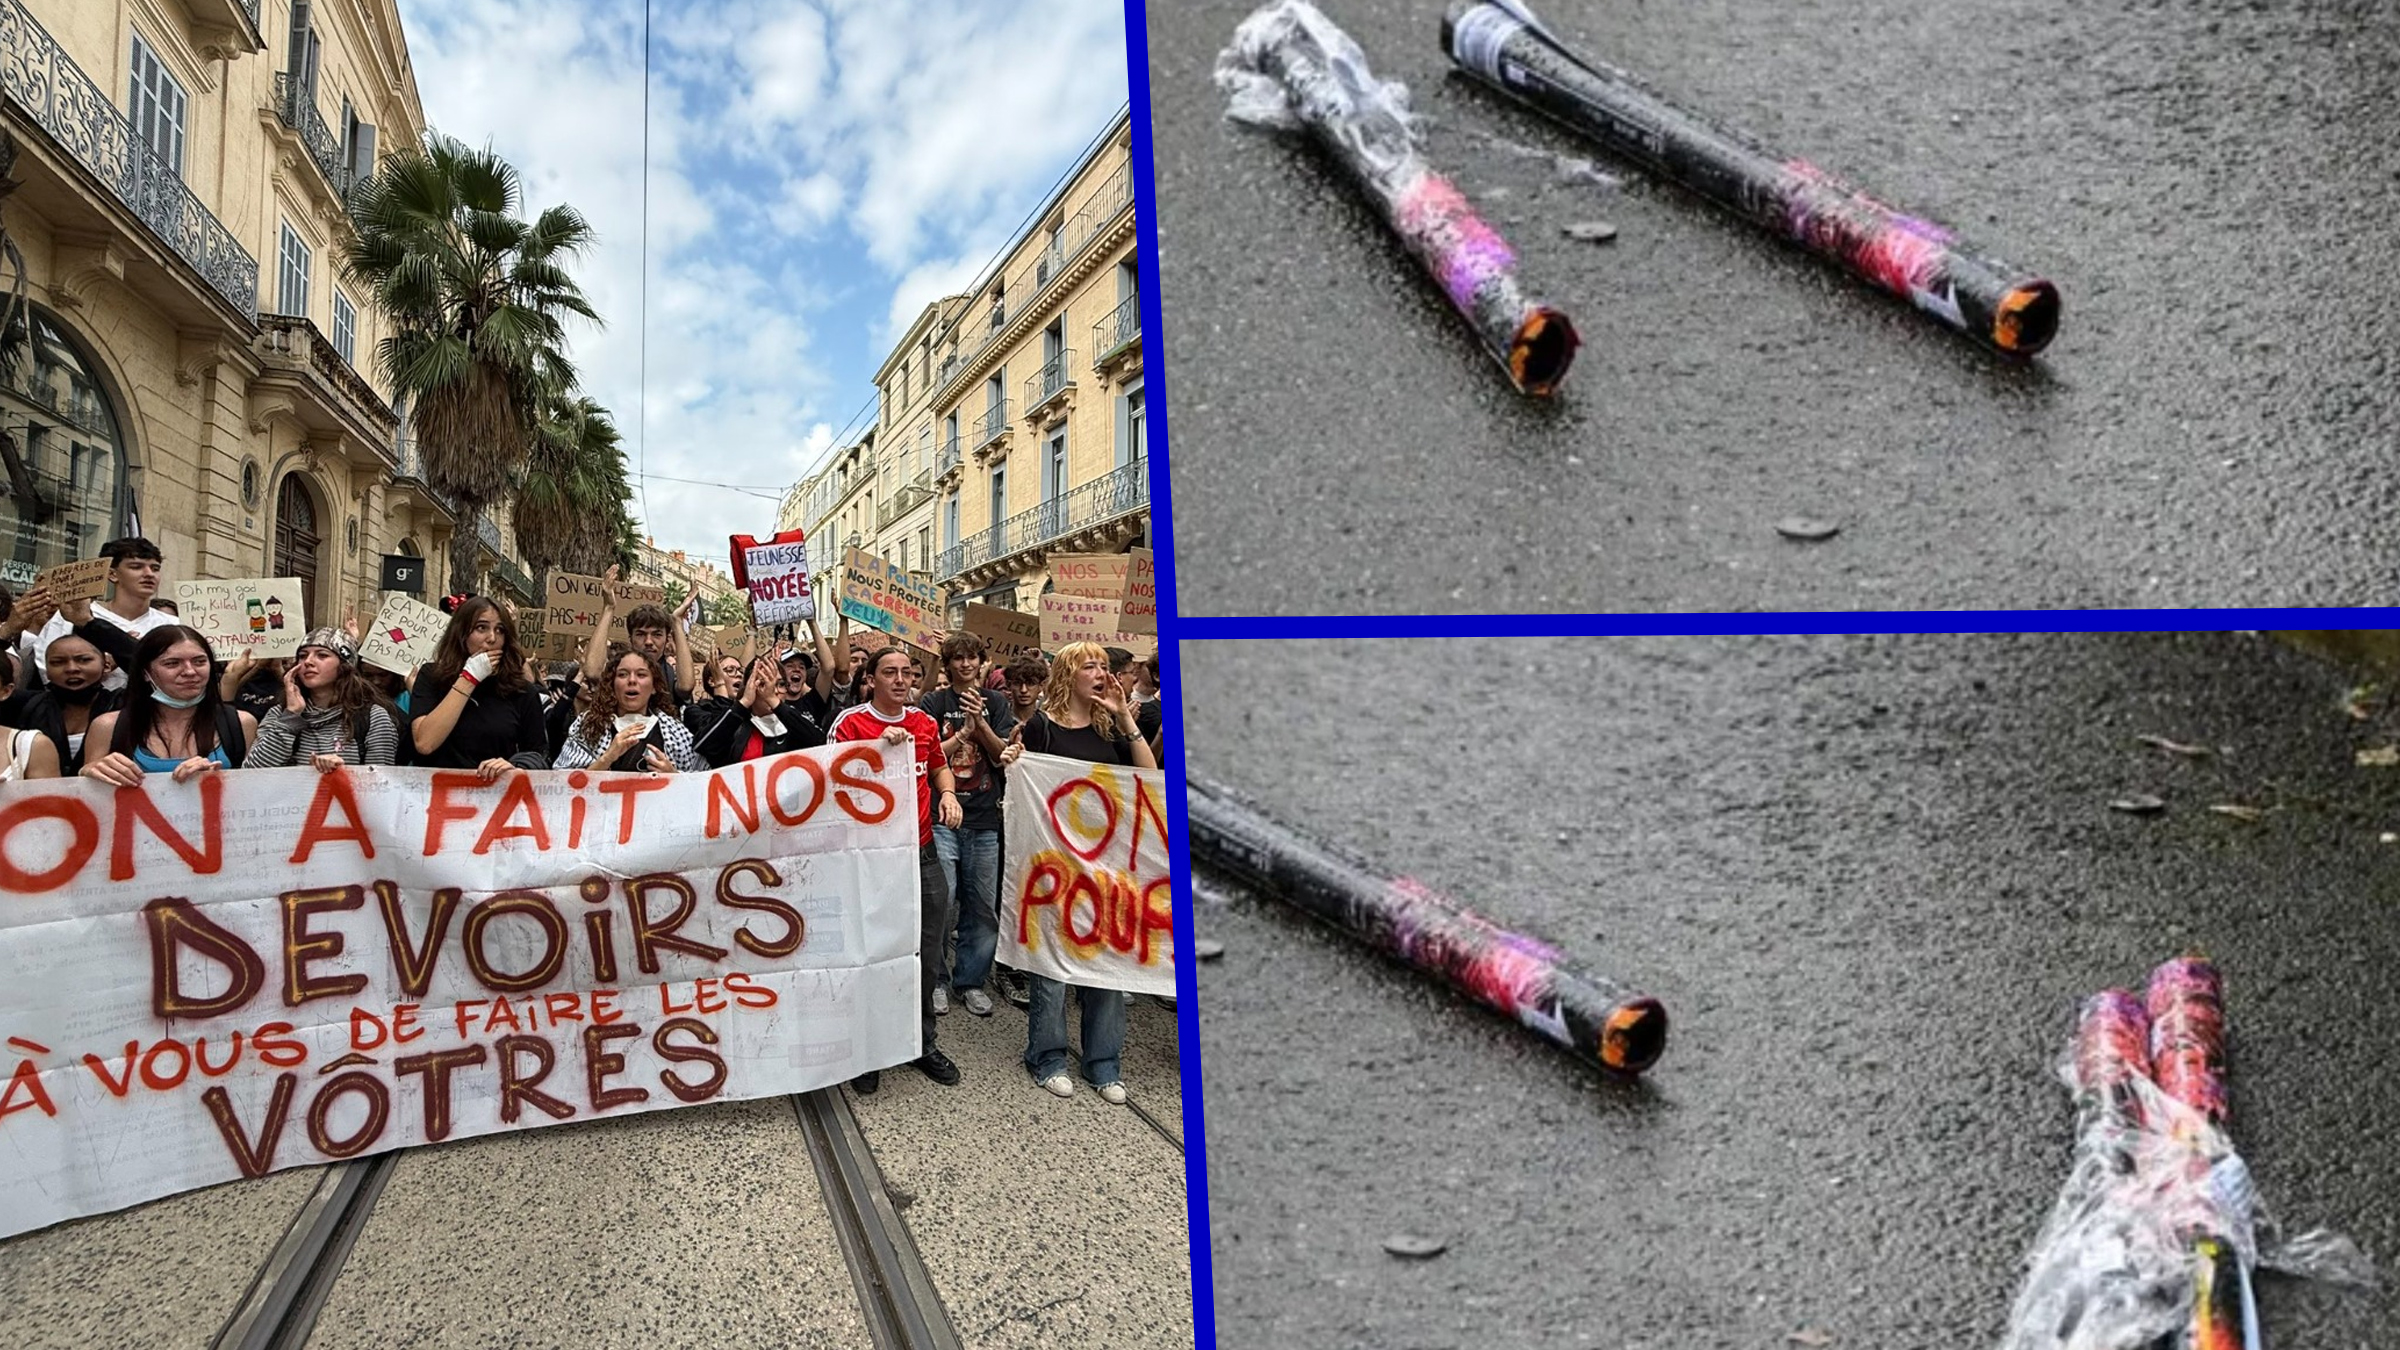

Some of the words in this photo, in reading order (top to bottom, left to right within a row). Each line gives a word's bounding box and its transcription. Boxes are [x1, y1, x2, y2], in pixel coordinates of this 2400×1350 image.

[746, 545, 806, 566] JEUNESSE
[854, 552, 881, 574] LA
[1058, 563, 1099, 581] NOS
[179, 584, 203, 598] Oh
[235, 582, 257, 600] god
[556, 576, 579, 594] ON
[634, 588, 663, 602] DROITS
[750, 567, 811, 603] NOYÉE
[846, 568, 884, 590] NOUS
[889, 583, 942, 617] PROTÈGE
[846, 584, 873, 602] CA
[180, 600, 206, 618] They
[209, 598, 237, 611] Killed
[389, 596, 412, 615] CA
[755, 600, 814, 625] RÉFORMES
[843, 596, 889, 629] YEUX
[192, 614, 220, 629] US
[518, 619, 546, 635] BLUE
[550, 607, 575, 626] PAS
[398, 616, 428, 639] POUR
[270, 636, 297, 650] your
[367, 639, 392, 657] PAS
[0, 773, 223, 894] ON
[288, 768, 375, 864] A
[705, 747, 895, 840] NOS
[1047, 773, 1169, 871] ON
[0, 1036, 57, 1118] À
[83, 1021, 308, 1097] VOUS
[350, 1004, 424, 1051] DE
[660, 972, 777, 1015] LES
[201, 1016, 728, 1180] VÔTRES
